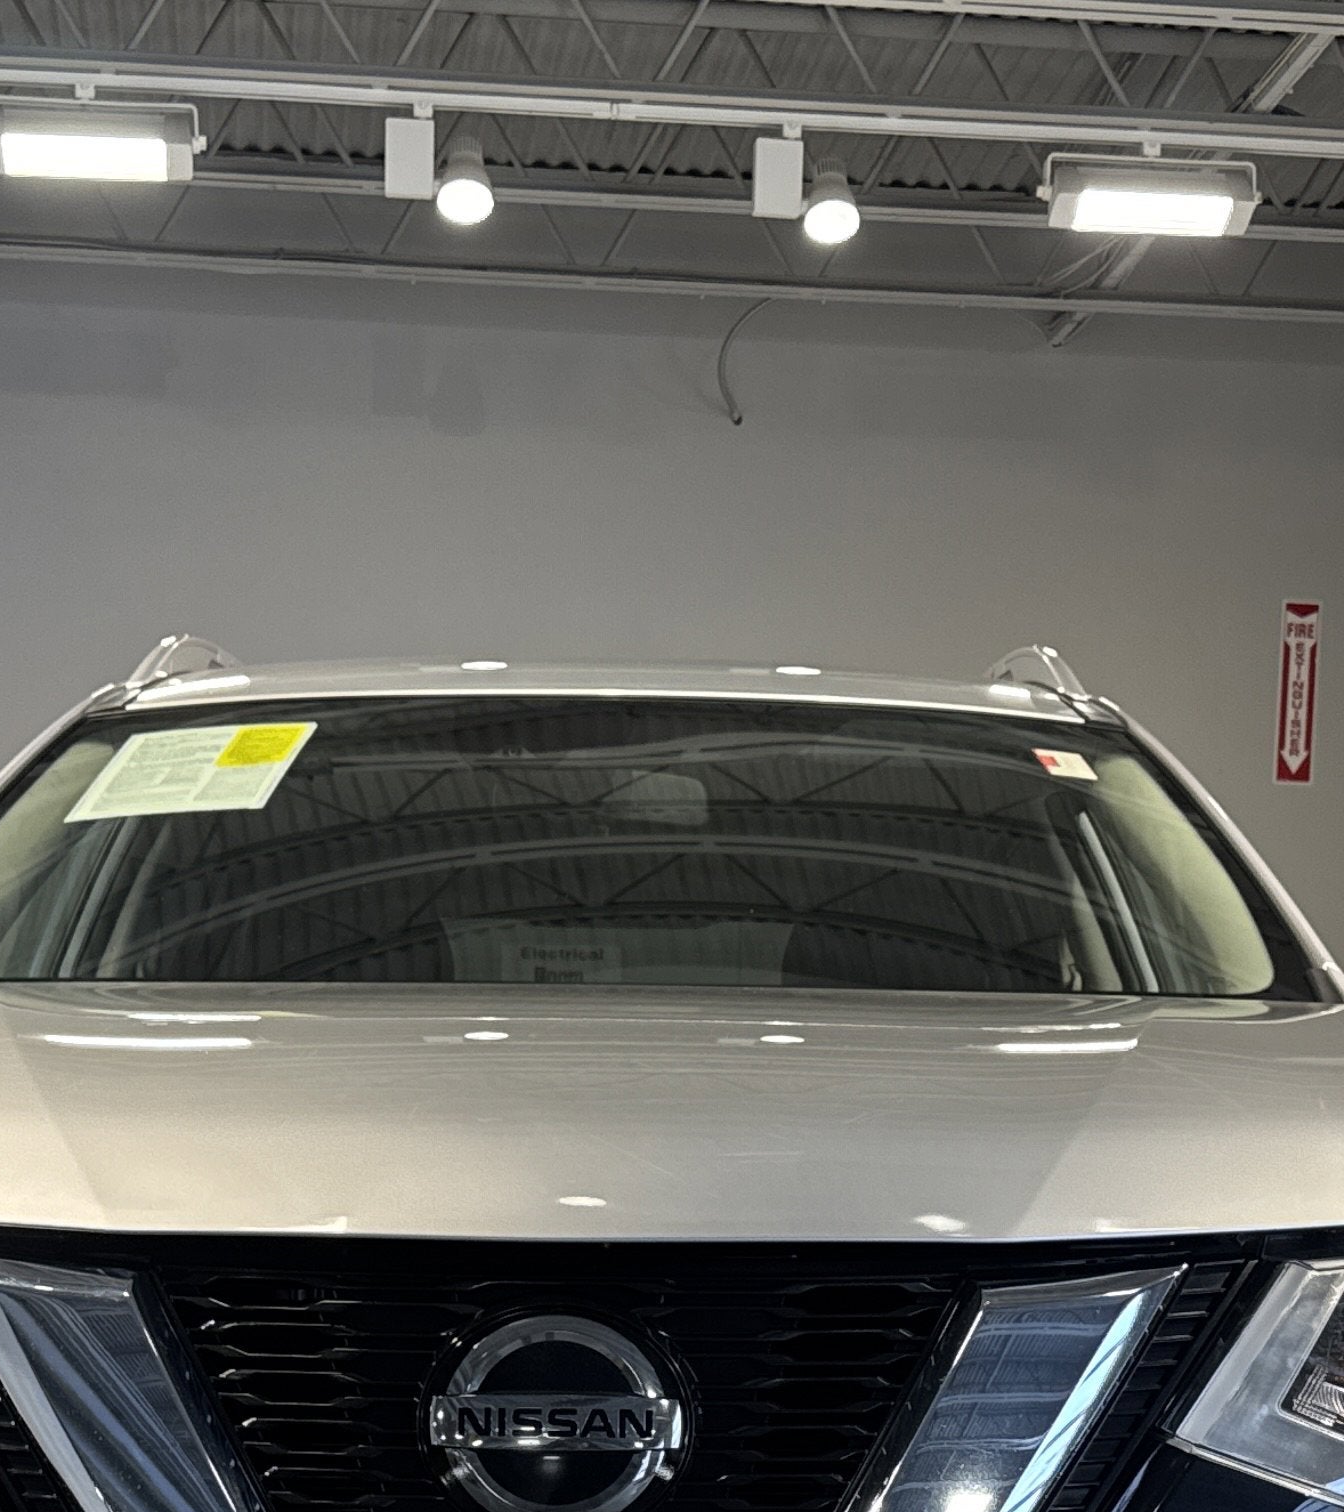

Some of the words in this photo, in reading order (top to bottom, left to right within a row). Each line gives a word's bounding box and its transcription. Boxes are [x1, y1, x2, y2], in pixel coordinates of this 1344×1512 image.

[1287, 623, 1315, 639] FIRE
[1289, 642, 1305, 757] EXTINGUISHER
[520, 946, 605, 961] Electrical
[458, 1407, 653, 1439] NISSAN
